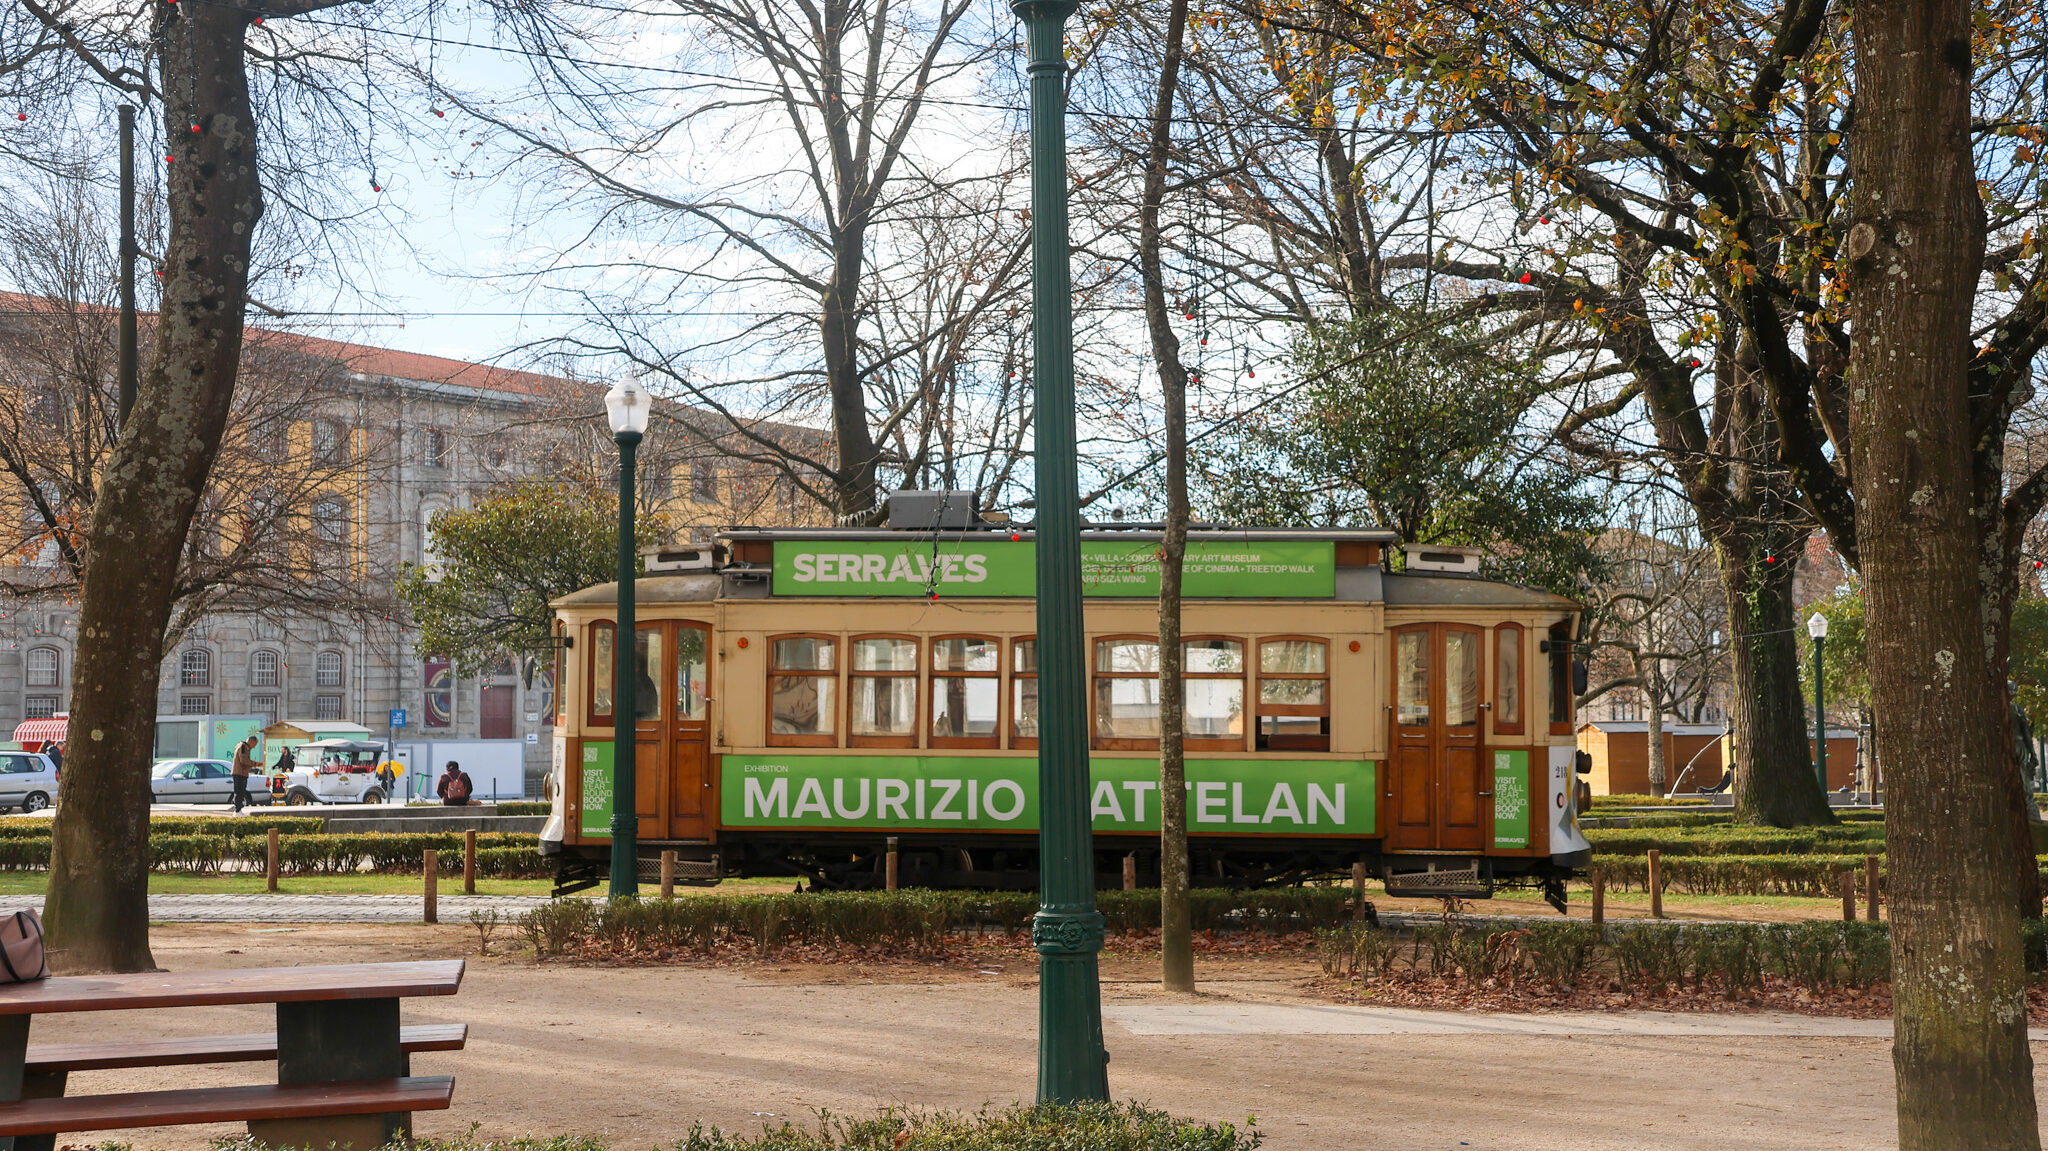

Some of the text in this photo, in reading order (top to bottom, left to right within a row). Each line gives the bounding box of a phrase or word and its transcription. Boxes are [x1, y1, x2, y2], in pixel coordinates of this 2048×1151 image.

[1094, 554, 1120, 562] VILLA
[1126, 554, 1200, 562] CONTARY
[1202, 554, 1219, 562] ART
[1221, 554, 1260, 562] MUSEUM
[792, 553, 988, 583] SERRAVES
[1191, 565, 1203, 573] OF
[1205, 565, 1240, 573] CINEMA
[1246, 565, 1288, 573] TREETOP
[1289, 565, 1315, 573] WALK
[1100, 575, 1121, 583] SIZA
[1122, 575, 1147, 584] WING
[583, 769, 604, 777] VISIT
[744, 765, 789, 773] EXHIBITION
[583, 776, 611, 784] US ALL
[1495, 776, 1517, 784] VISIT
[1508, 784, 1524, 792] ALL
[744, 777, 1026, 821] MAURIZIO
[1091, 780, 1346, 824] ATELAN
[1495, 798, 1528, 806] ROUND.
[1495, 805, 1520, 813] BOOK
[1495, 812, 1518, 820] NOW.
